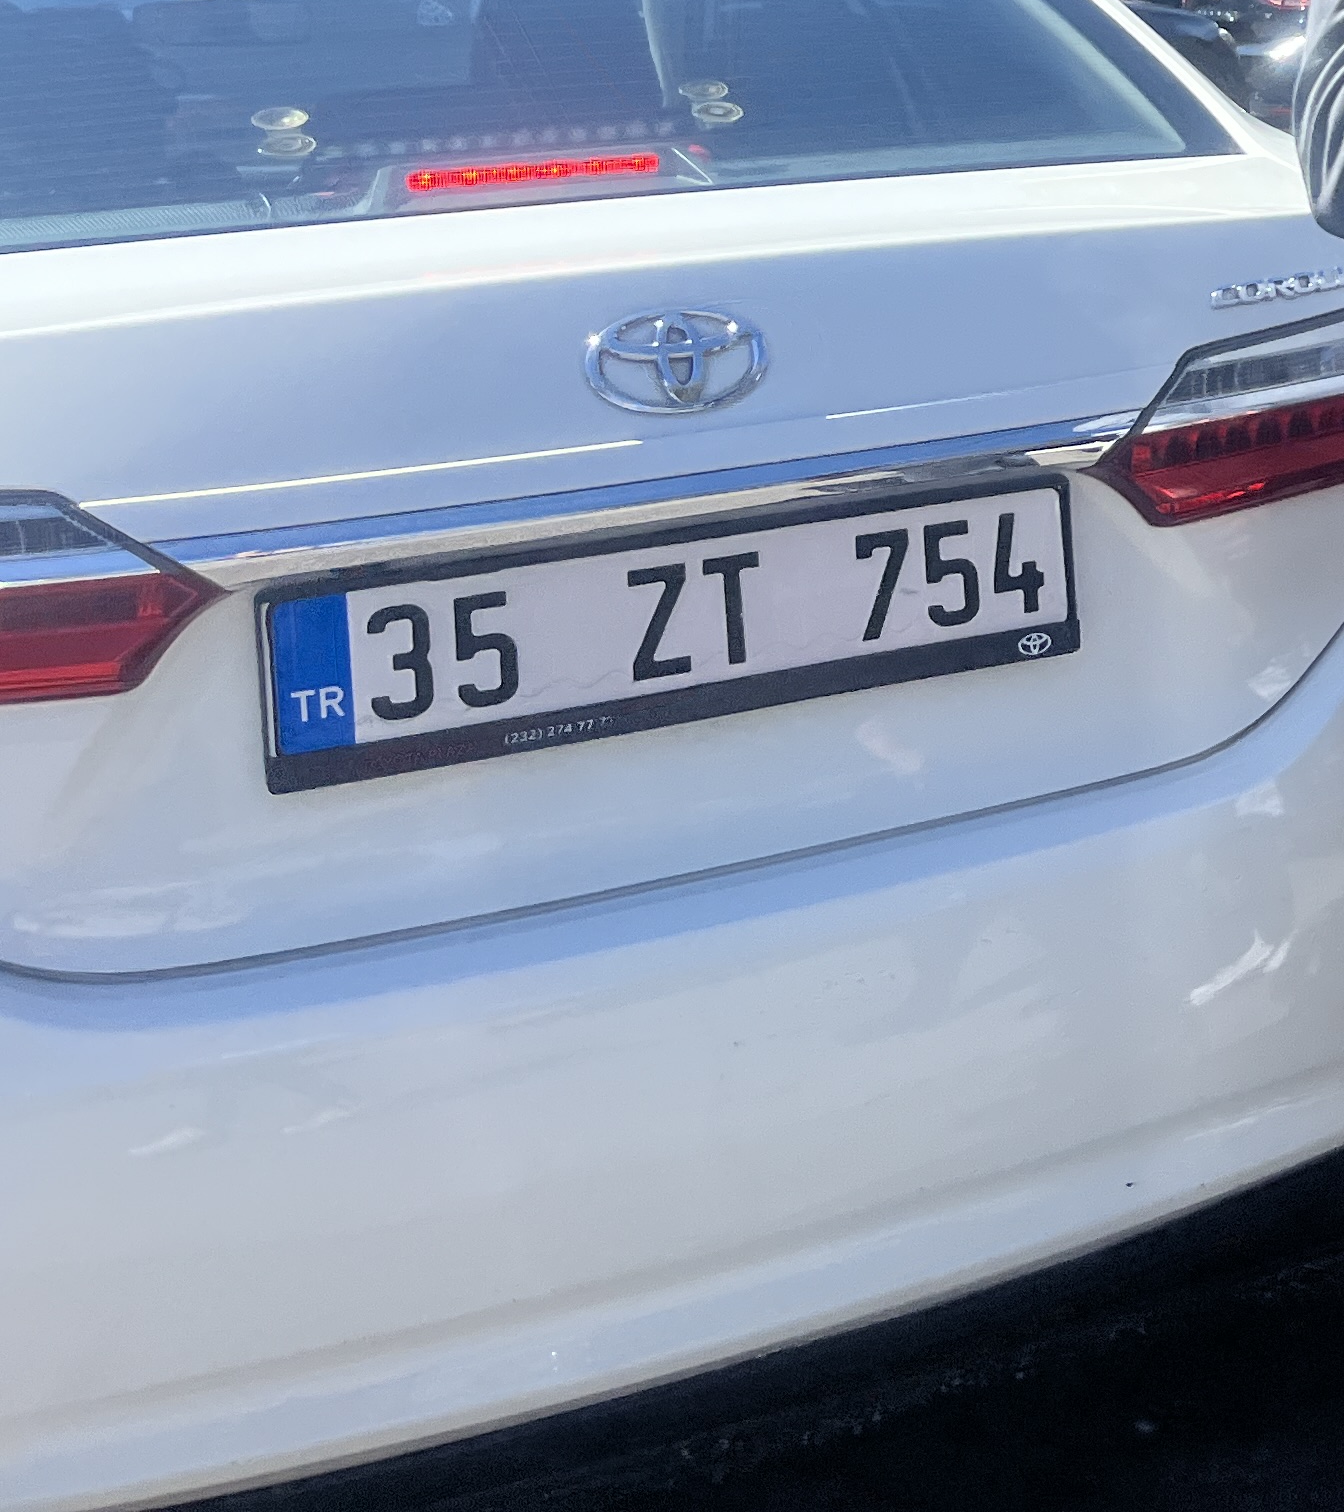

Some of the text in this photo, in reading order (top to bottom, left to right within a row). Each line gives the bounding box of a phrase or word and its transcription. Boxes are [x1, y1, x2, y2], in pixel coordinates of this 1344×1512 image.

[366, 512, 1045, 721] 35 ZT 754
[291, 686, 345, 722] TR
